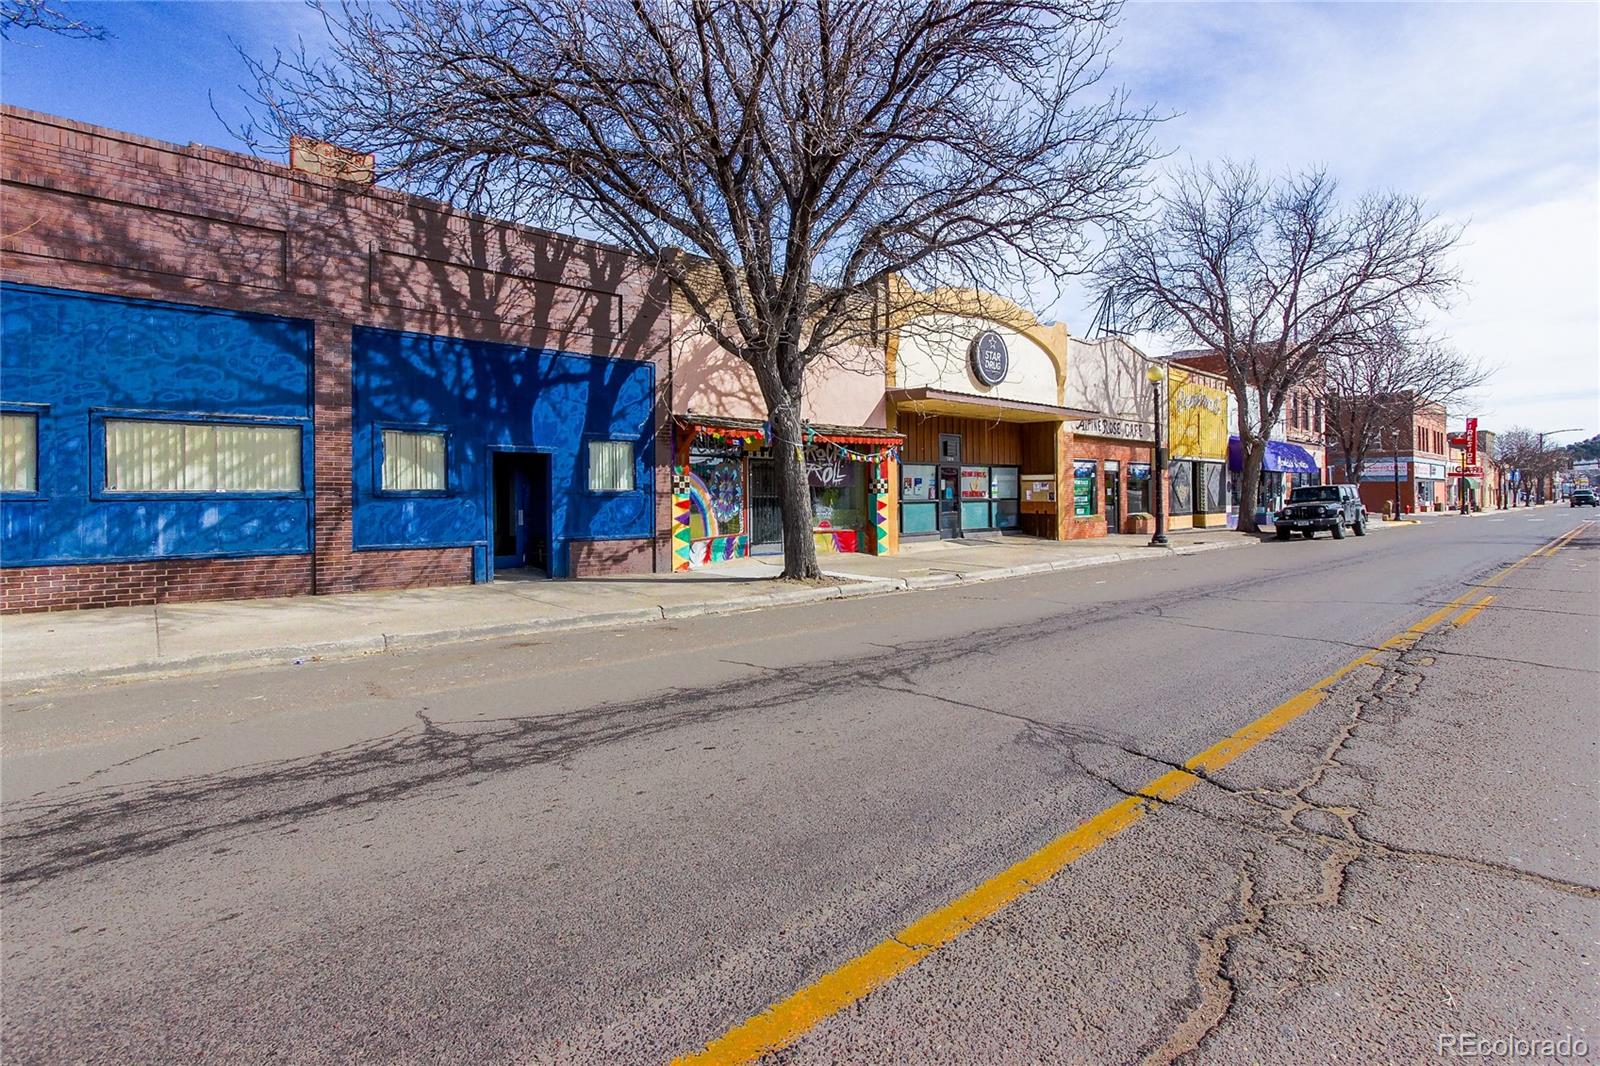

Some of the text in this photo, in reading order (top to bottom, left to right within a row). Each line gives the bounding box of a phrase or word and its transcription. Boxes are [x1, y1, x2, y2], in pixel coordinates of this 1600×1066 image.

[984, 350, 1001, 362] STAR
[984, 360, 1001, 371] DRUG
[1076, 420, 1143, 437] ALPINE ROSE CAFE
